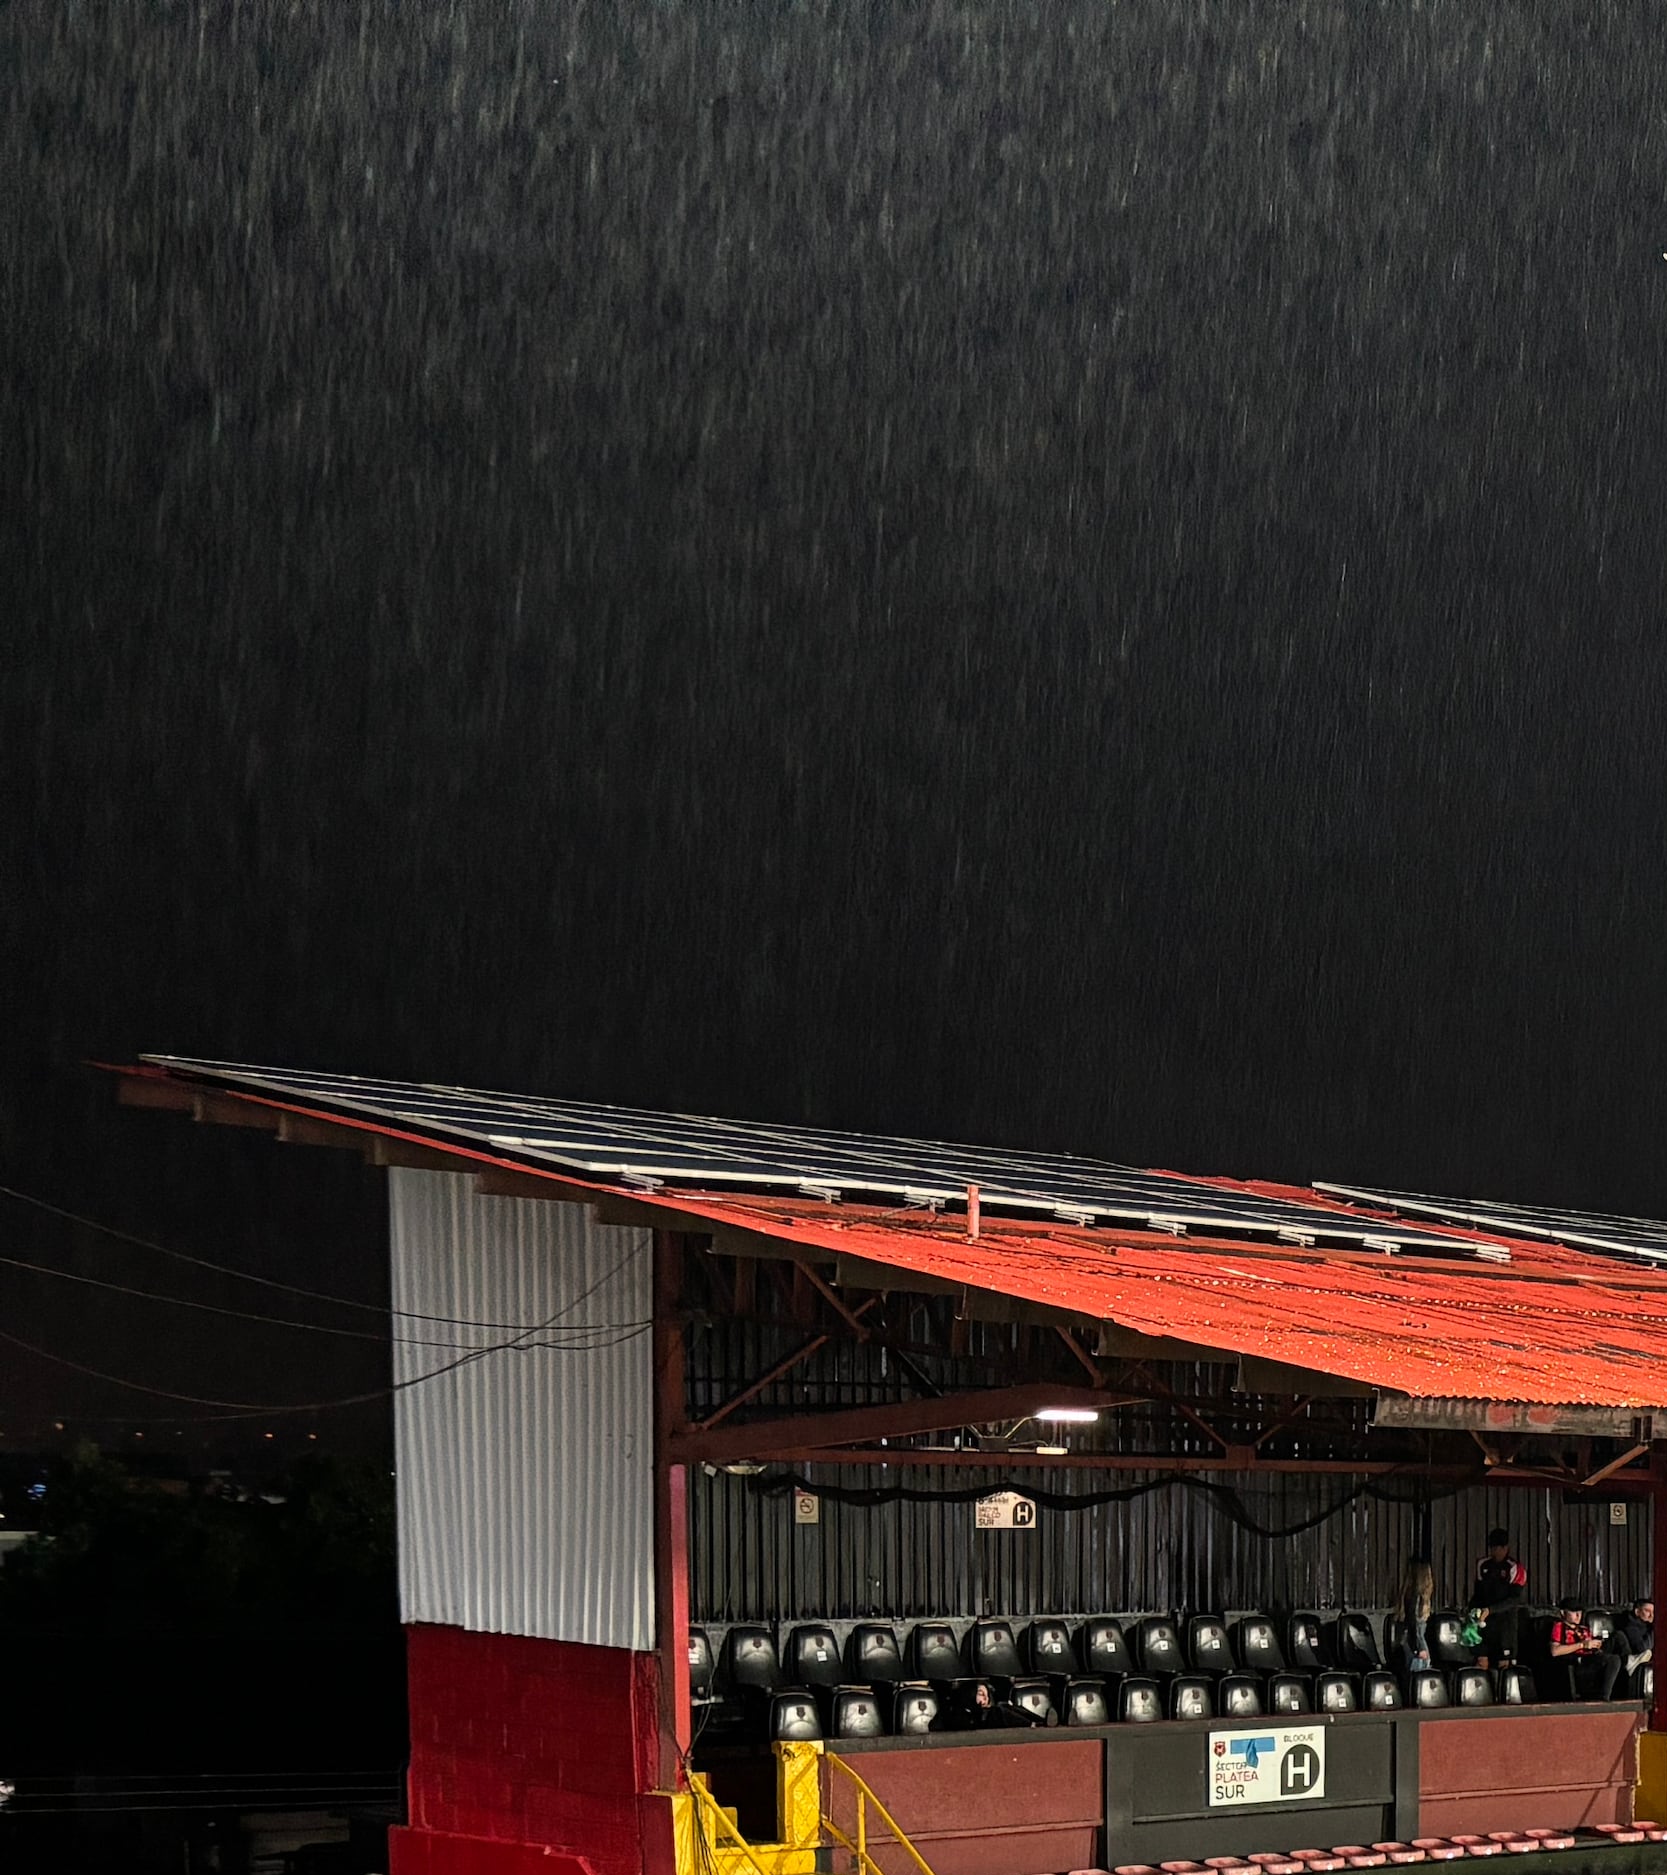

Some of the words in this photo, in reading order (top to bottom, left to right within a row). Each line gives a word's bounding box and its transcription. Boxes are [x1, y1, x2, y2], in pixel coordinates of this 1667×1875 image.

[1016, 1505, 1029, 1522] H
[1216, 1771, 1259, 1783] PLATEA
[1287, 1753, 1311, 1788] H
[1216, 1785, 1245, 1799] SUR
